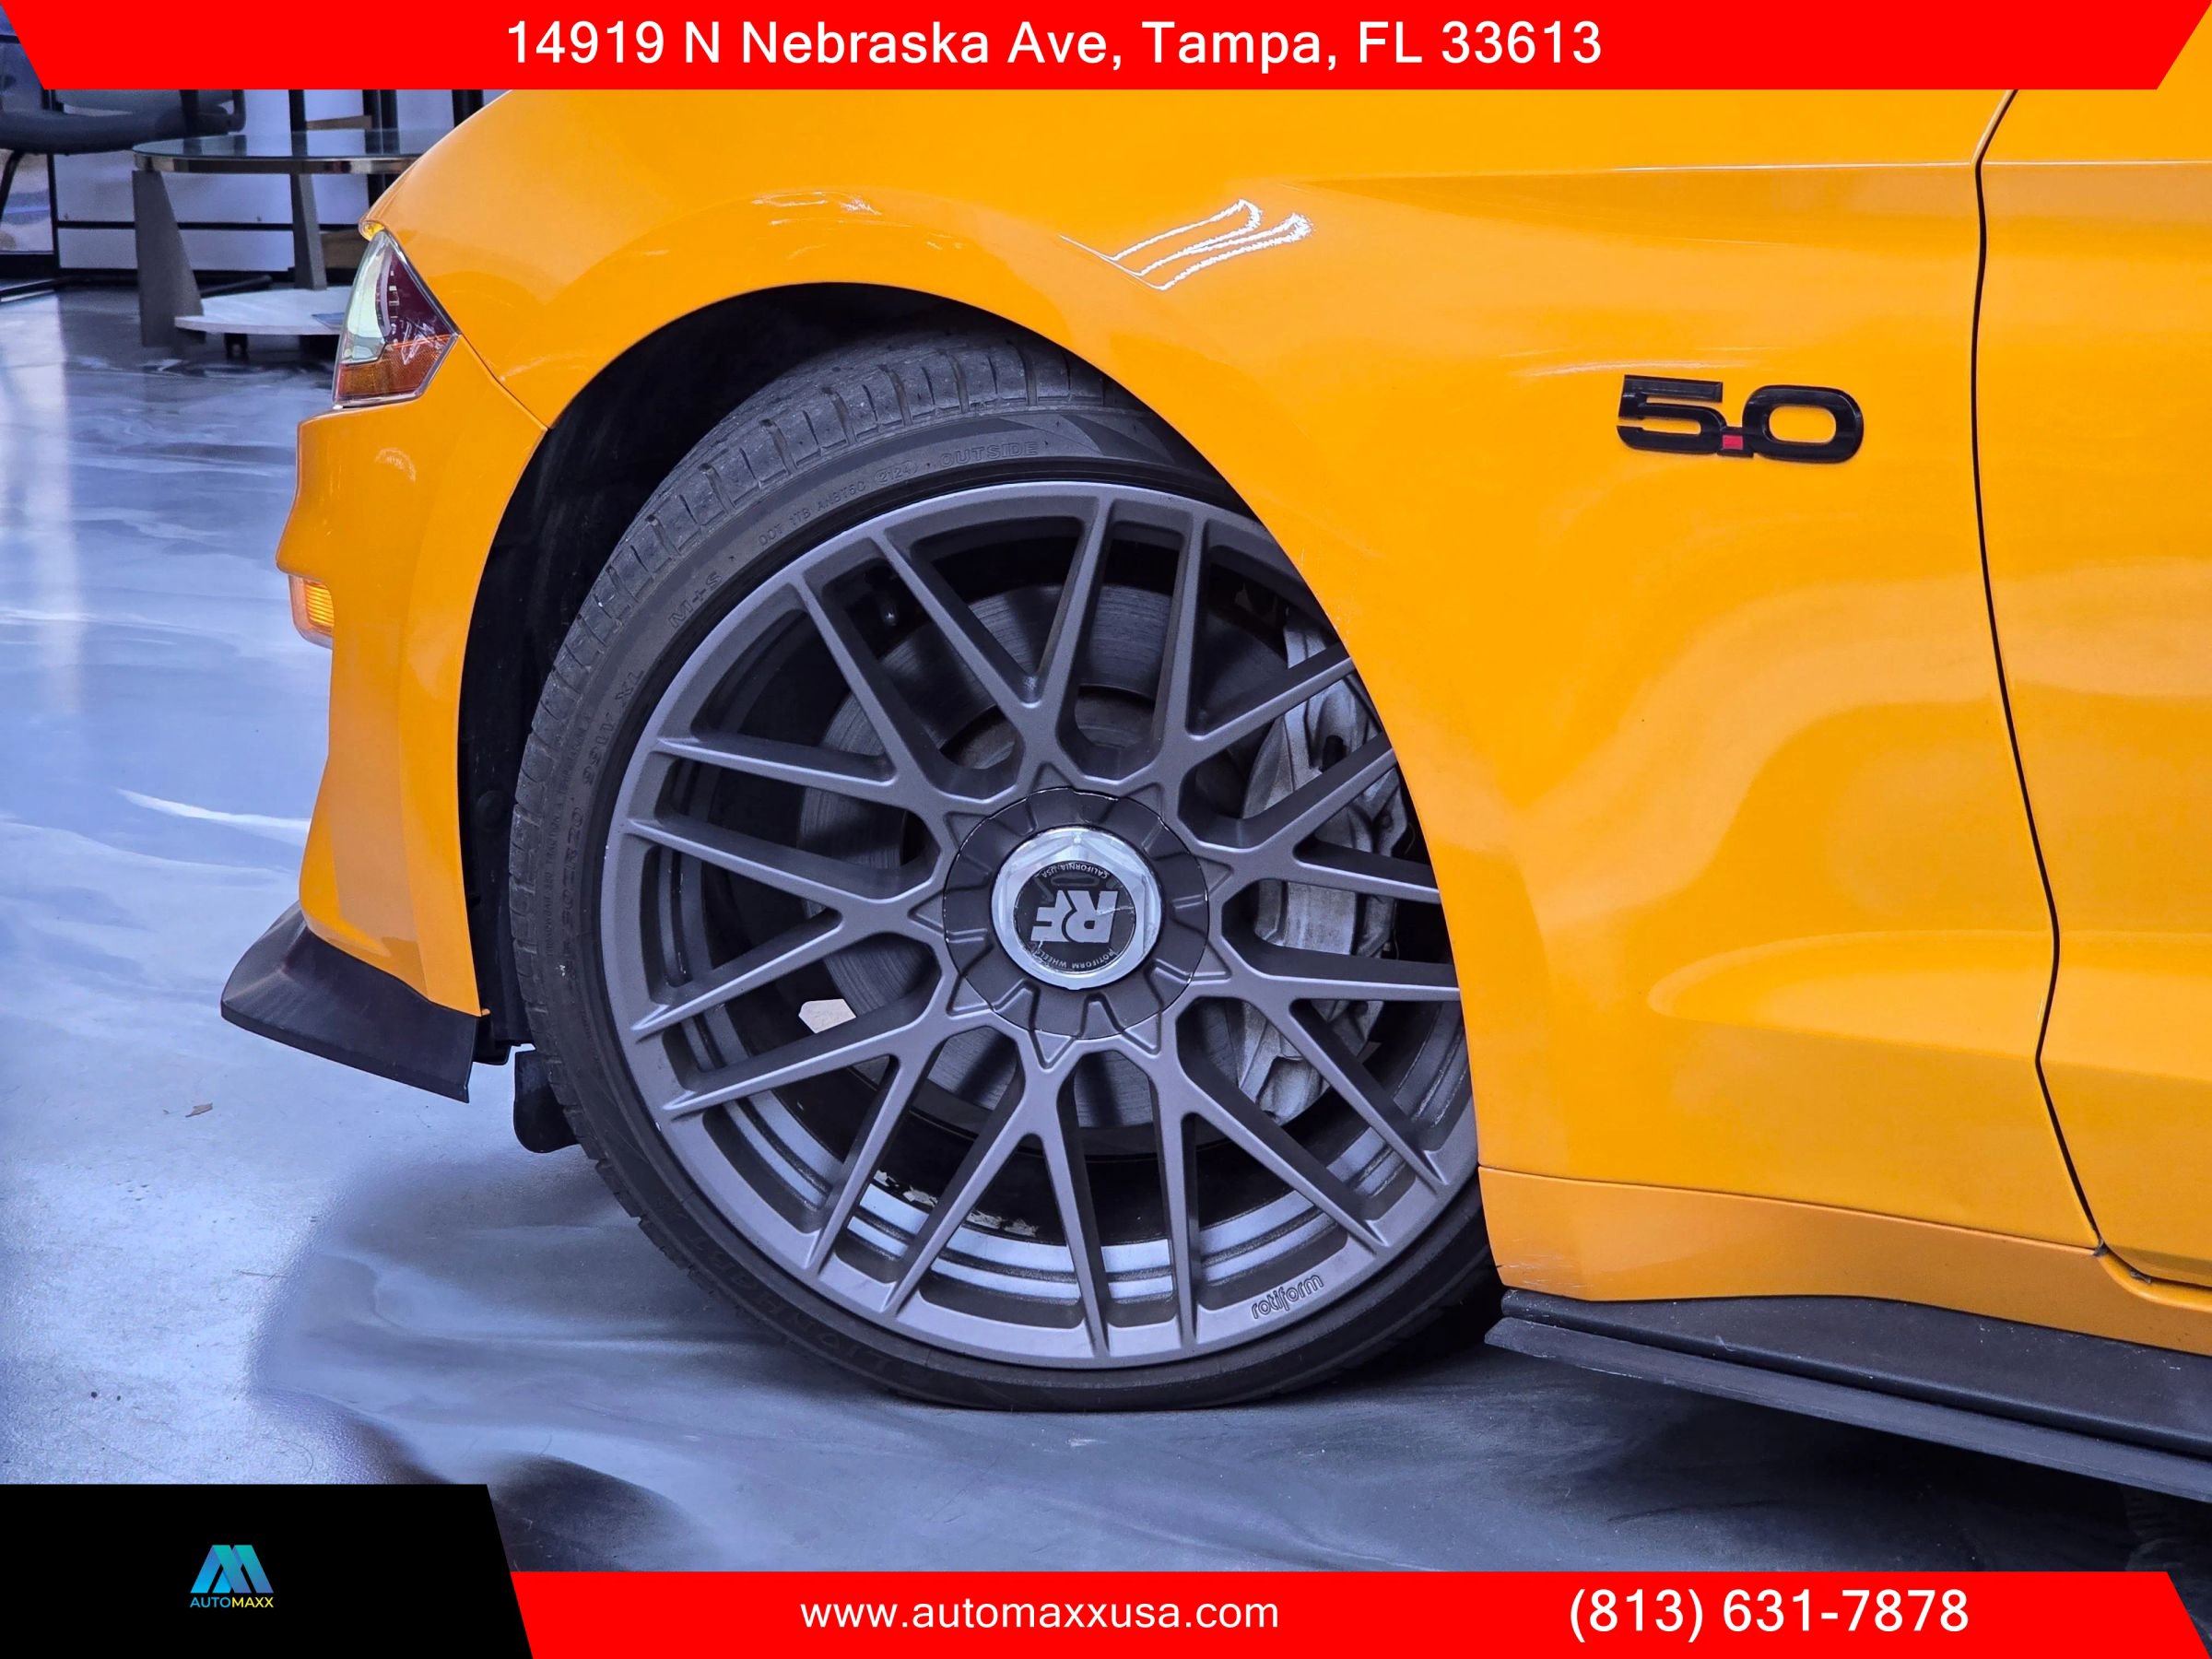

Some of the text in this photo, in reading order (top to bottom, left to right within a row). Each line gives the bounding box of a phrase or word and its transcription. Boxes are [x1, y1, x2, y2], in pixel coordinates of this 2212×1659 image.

[1617, 374, 1864, 464] 5.0
[941, 441, 1039, 466] OUTSIDE
[759, 524, 783, 547] DOT
[668, 572, 724, 629] M+S
[1041, 866, 1057, 877] USA
[1030, 890, 1118, 943] RF
[1071, 948, 1114, 969] ROTIFORM
[1251, 1275, 1324, 1319] rotiform
